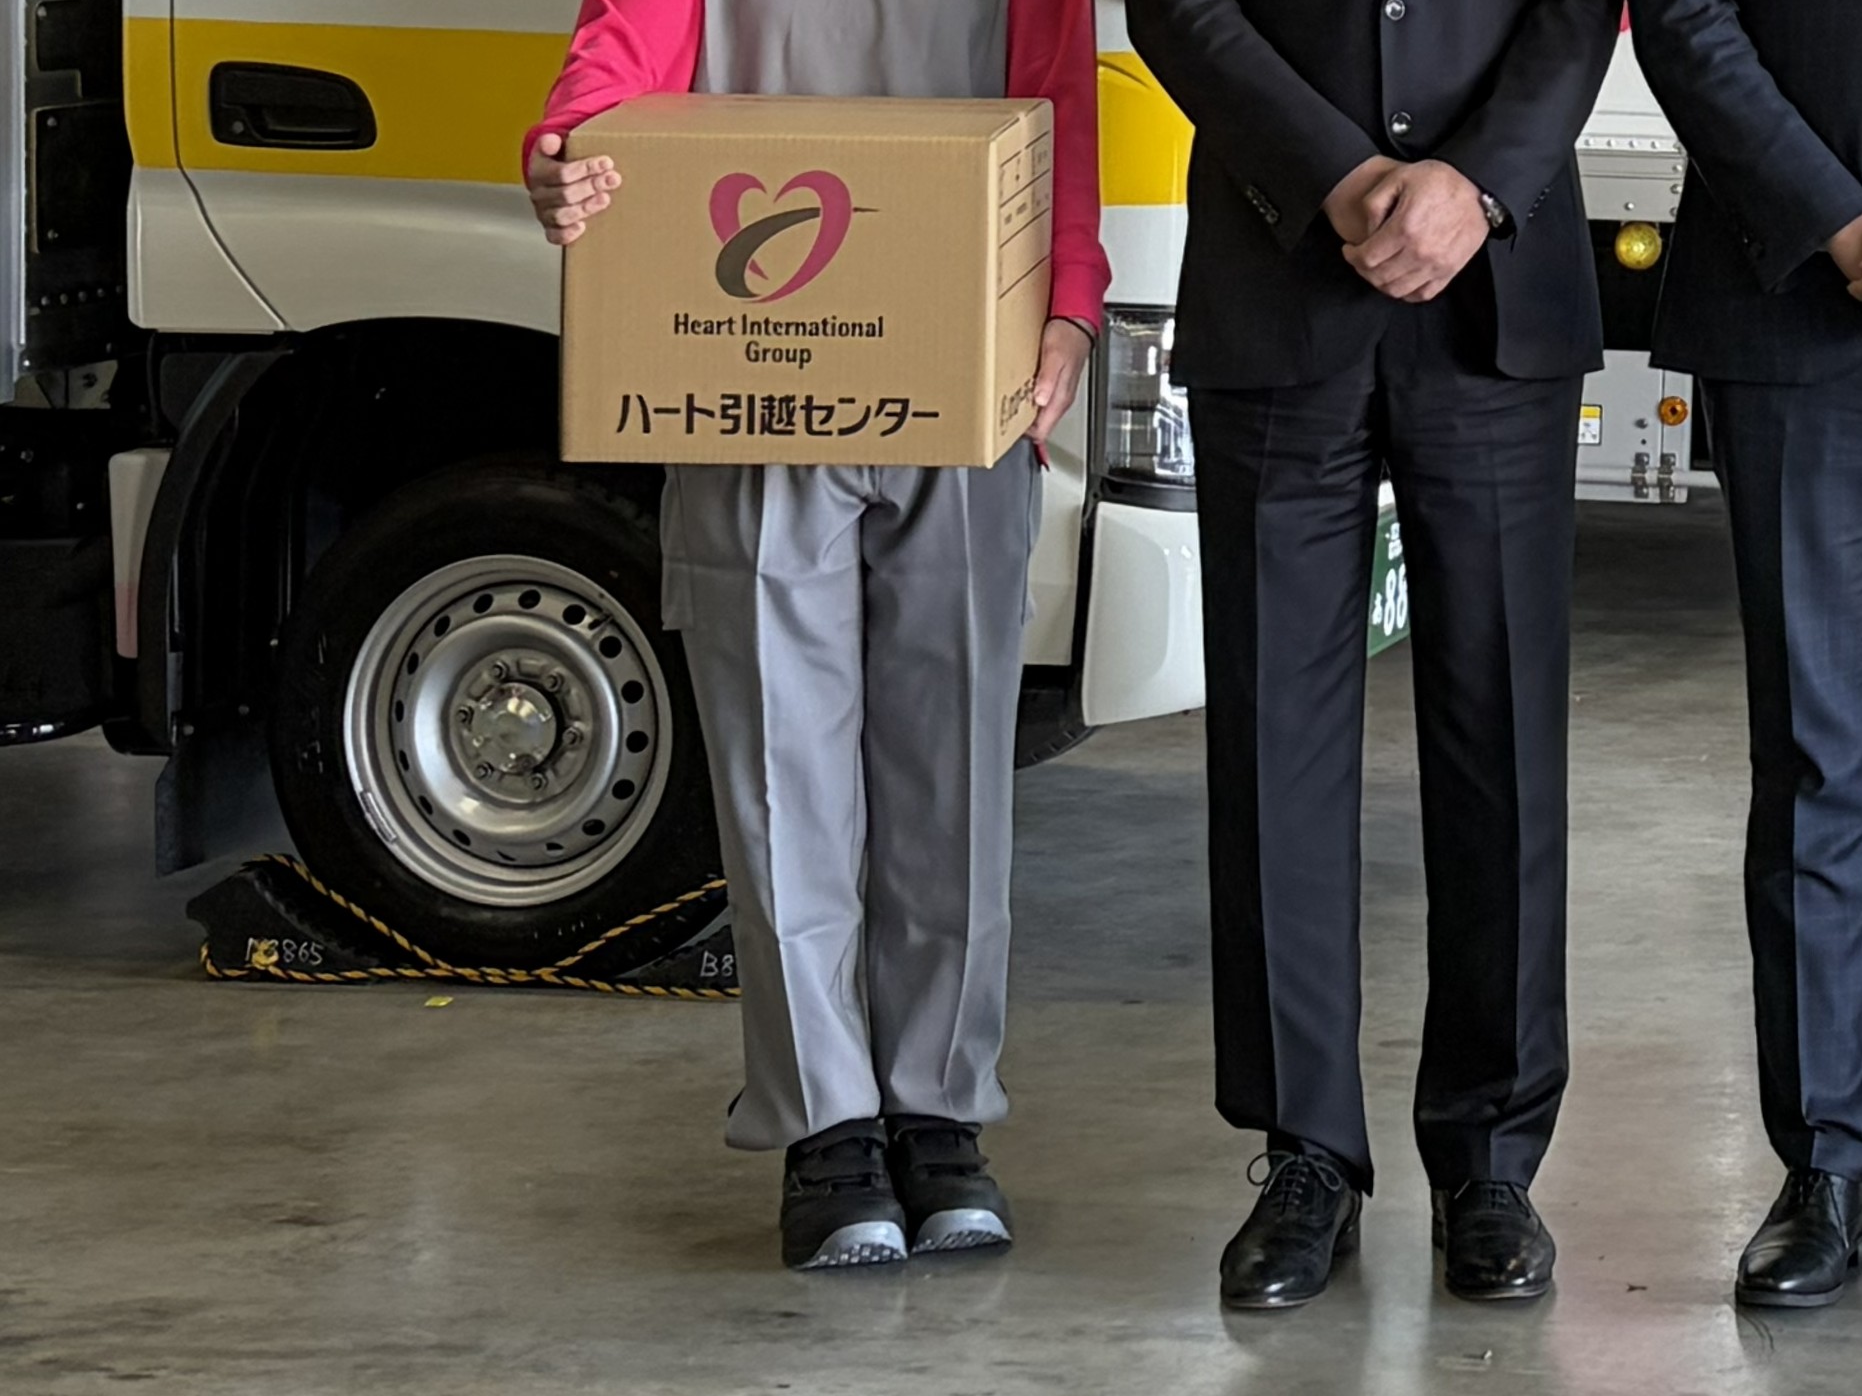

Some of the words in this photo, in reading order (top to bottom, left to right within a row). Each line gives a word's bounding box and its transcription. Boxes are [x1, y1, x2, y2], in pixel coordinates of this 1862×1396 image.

[673, 312, 736, 336] Heart
[741, 313, 884, 338] International
[744, 340, 812, 370] Group
[616, 392, 940, 438] ハート引越センター
